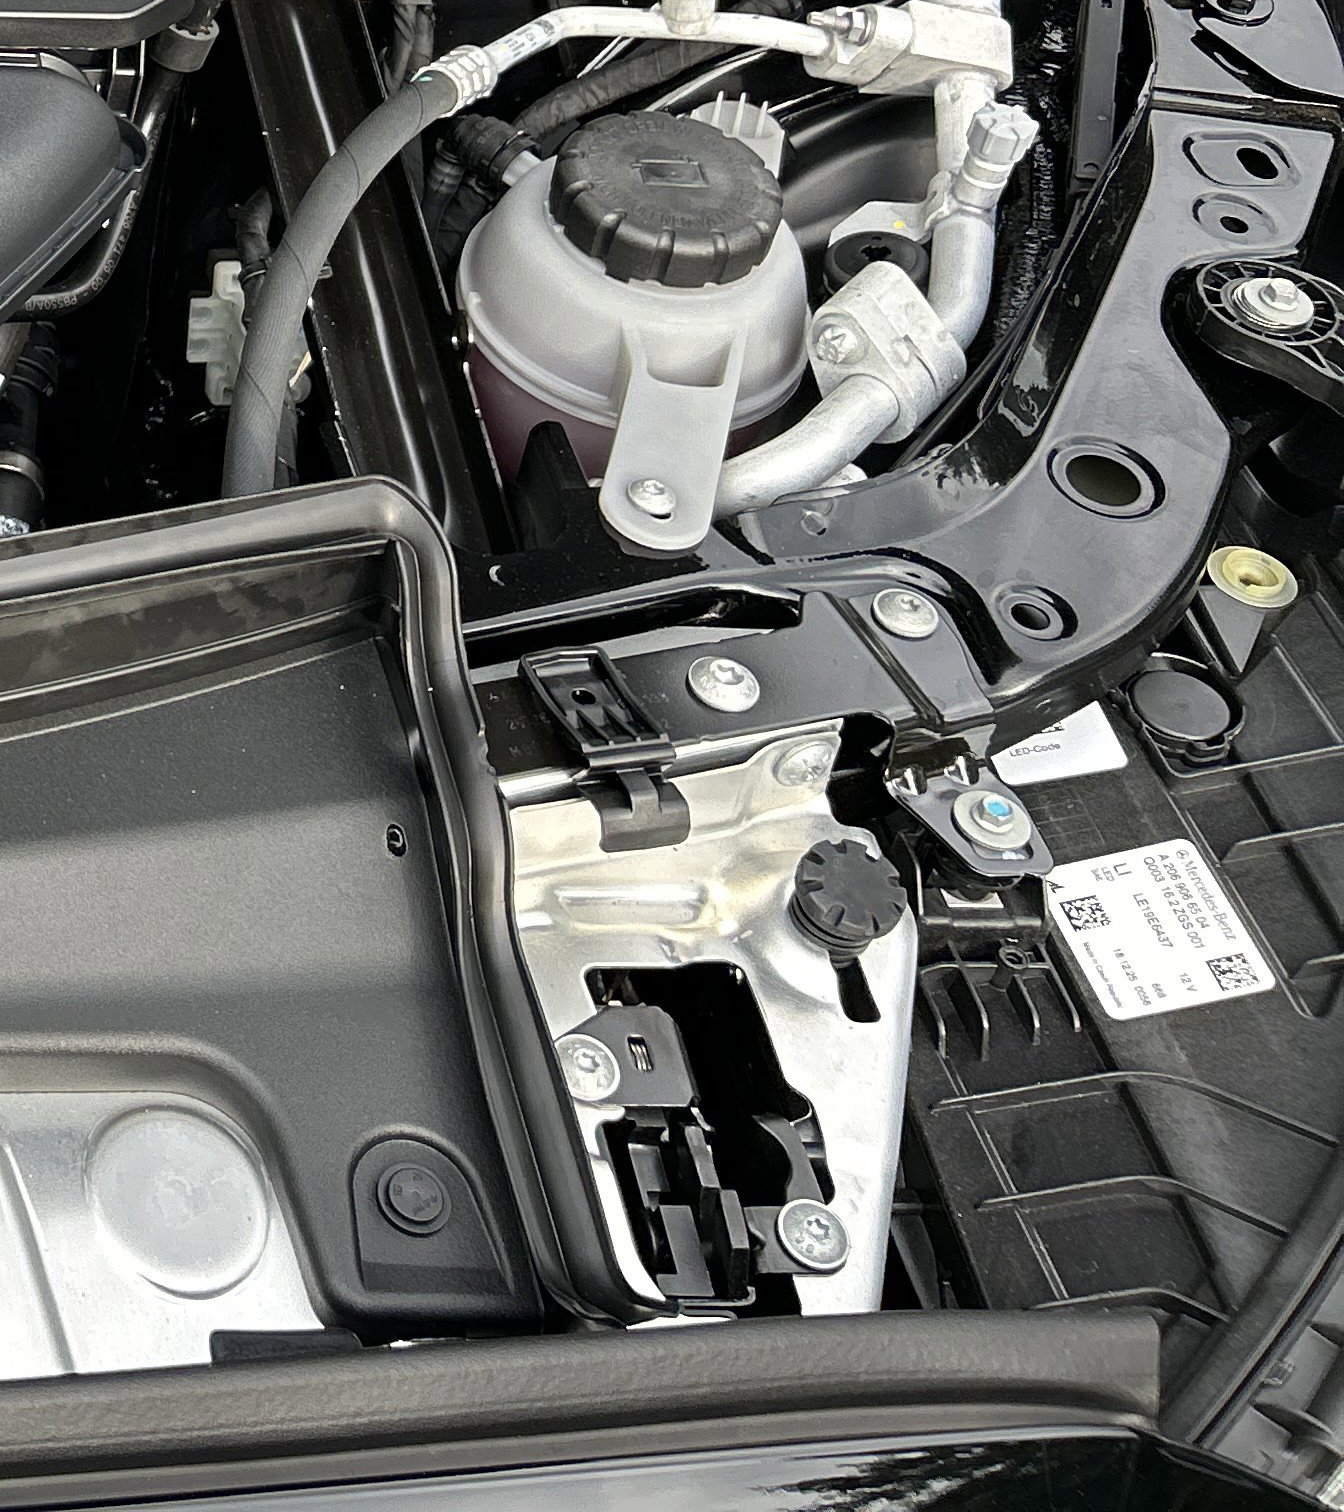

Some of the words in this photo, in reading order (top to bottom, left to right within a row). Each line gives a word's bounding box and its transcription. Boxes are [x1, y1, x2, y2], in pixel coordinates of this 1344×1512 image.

[1009, 741, 1061, 759] LED-Code
[1182, 860, 1236, 941] Mercedes-Benz
[1172, 907, 1194, 931] ZGS
